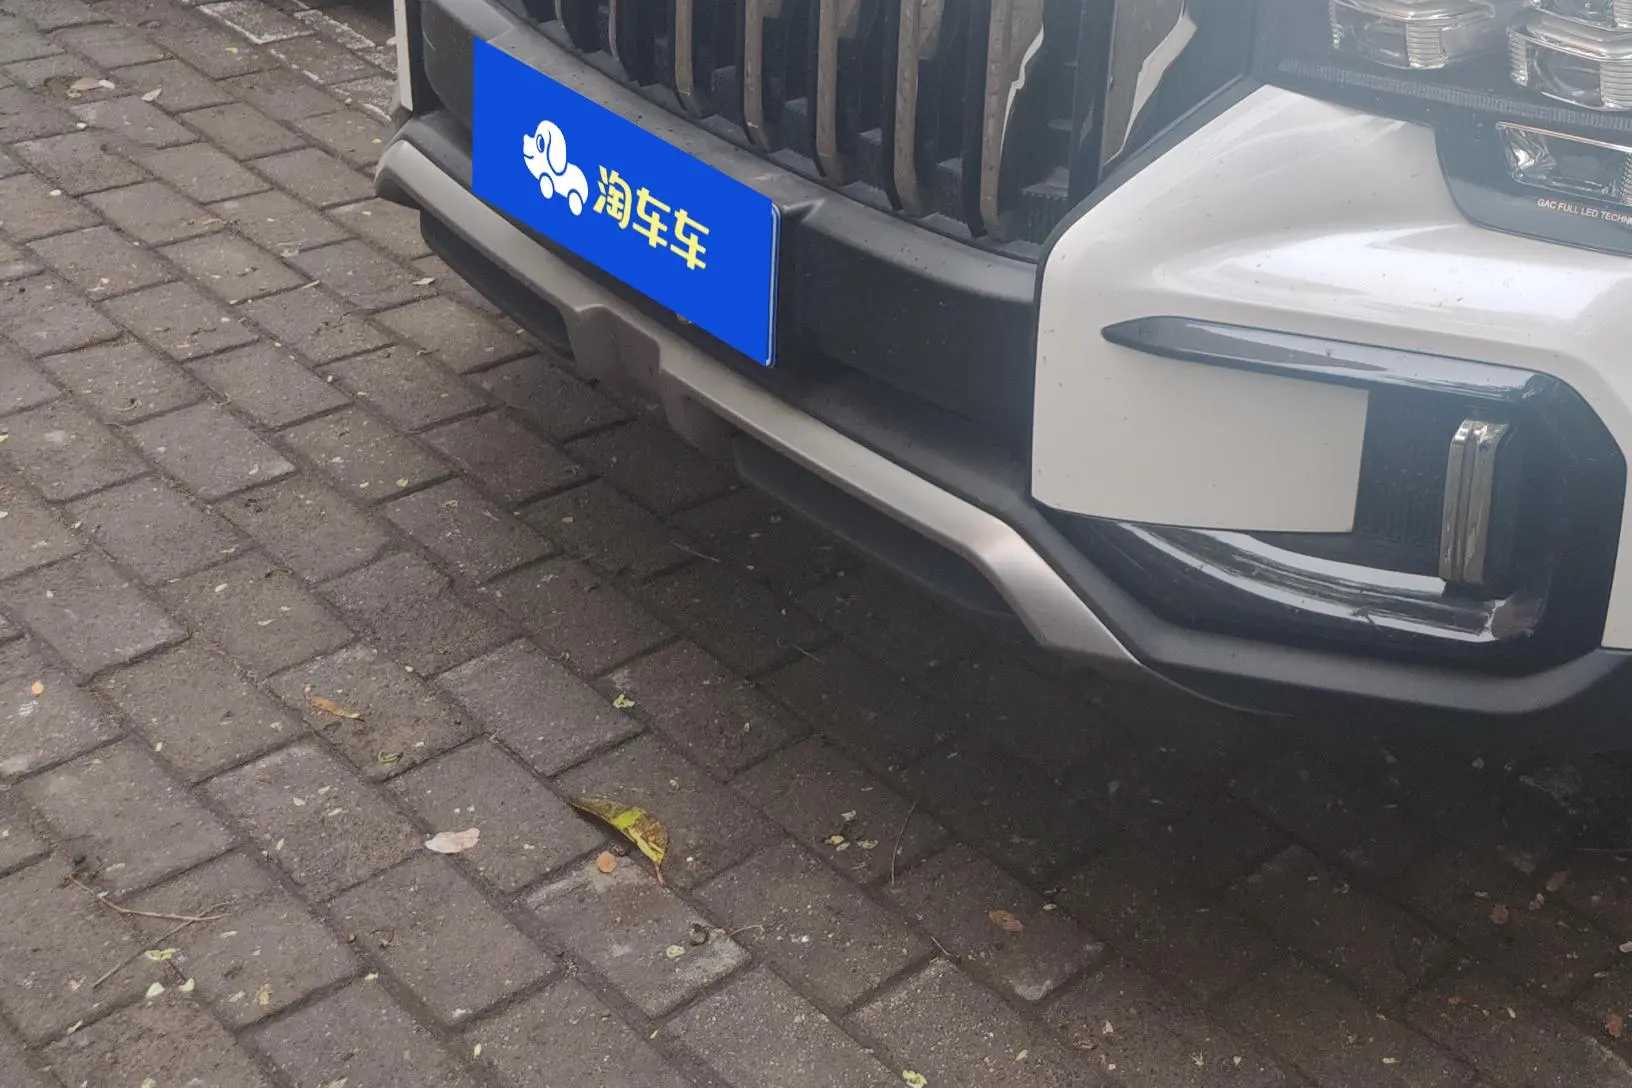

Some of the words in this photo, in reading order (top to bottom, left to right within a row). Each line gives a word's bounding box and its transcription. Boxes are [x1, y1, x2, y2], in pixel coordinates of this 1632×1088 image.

[1537, 197, 1557, 210] GAC
[1557, 202, 1580, 216] FULL
[1580, 207, 1599, 219] LED
